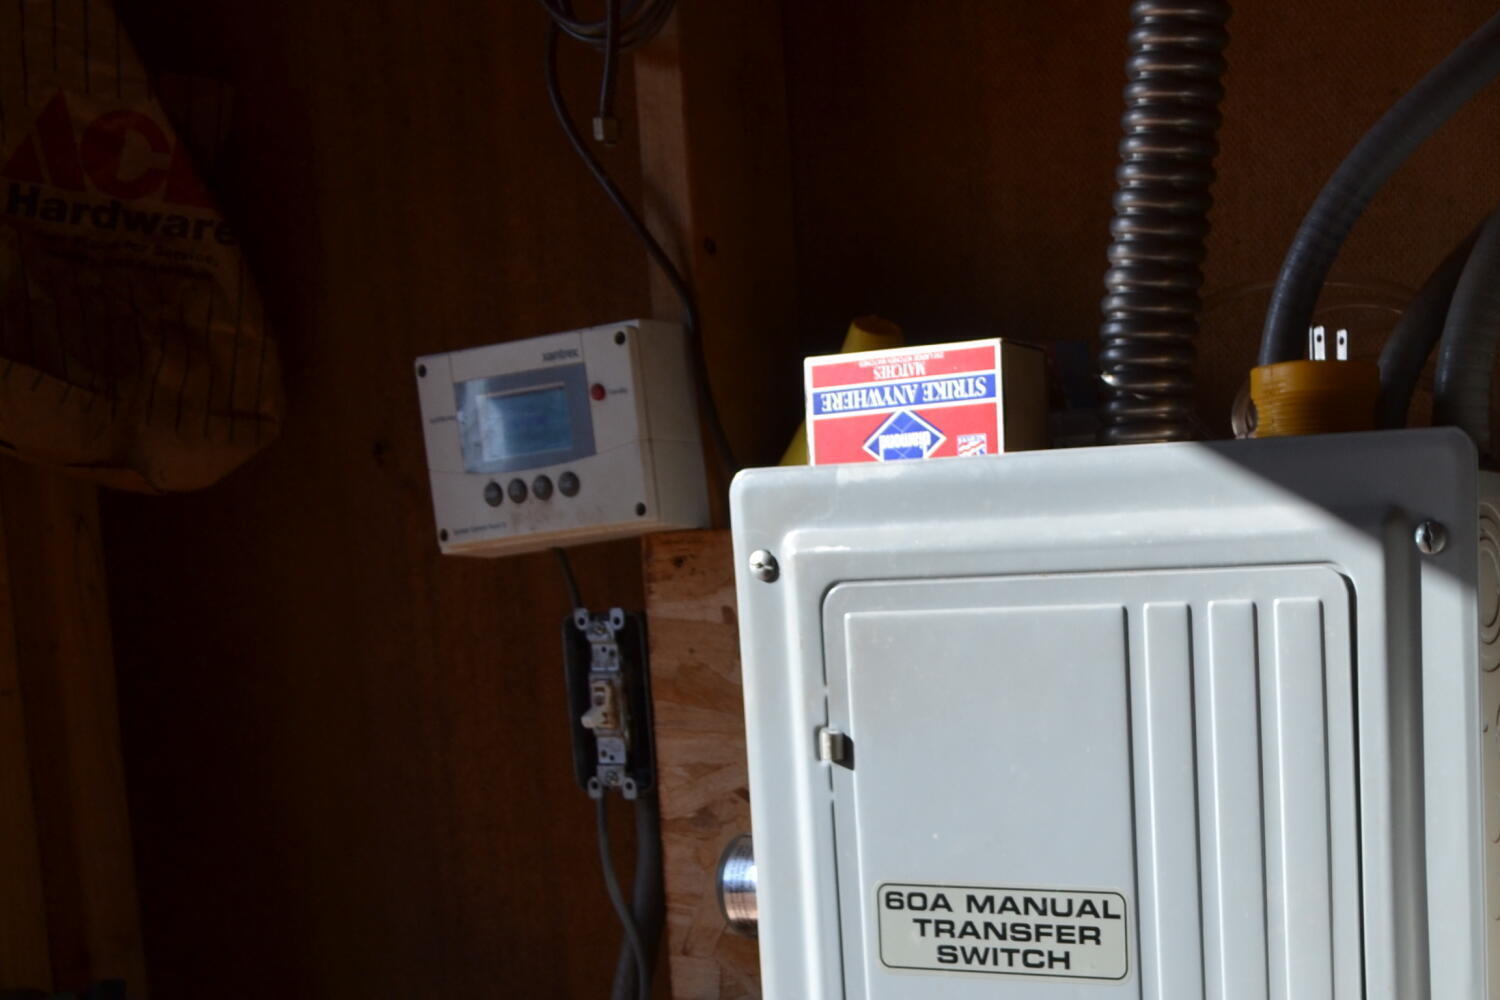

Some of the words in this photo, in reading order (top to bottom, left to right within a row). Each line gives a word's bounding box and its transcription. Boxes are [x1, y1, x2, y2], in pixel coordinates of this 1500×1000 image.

[873, 361, 926, 380] MATCHES
[820, 383, 920, 412] ANYWHERE
[923, 376, 988, 402] STRIKE
[884, 890, 953, 912] 60A
[965, 894, 1121, 919] MANUAL
[912, 918, 1102, 945] TRANSFER
[936, 945, 1070, 970] SWITCH
